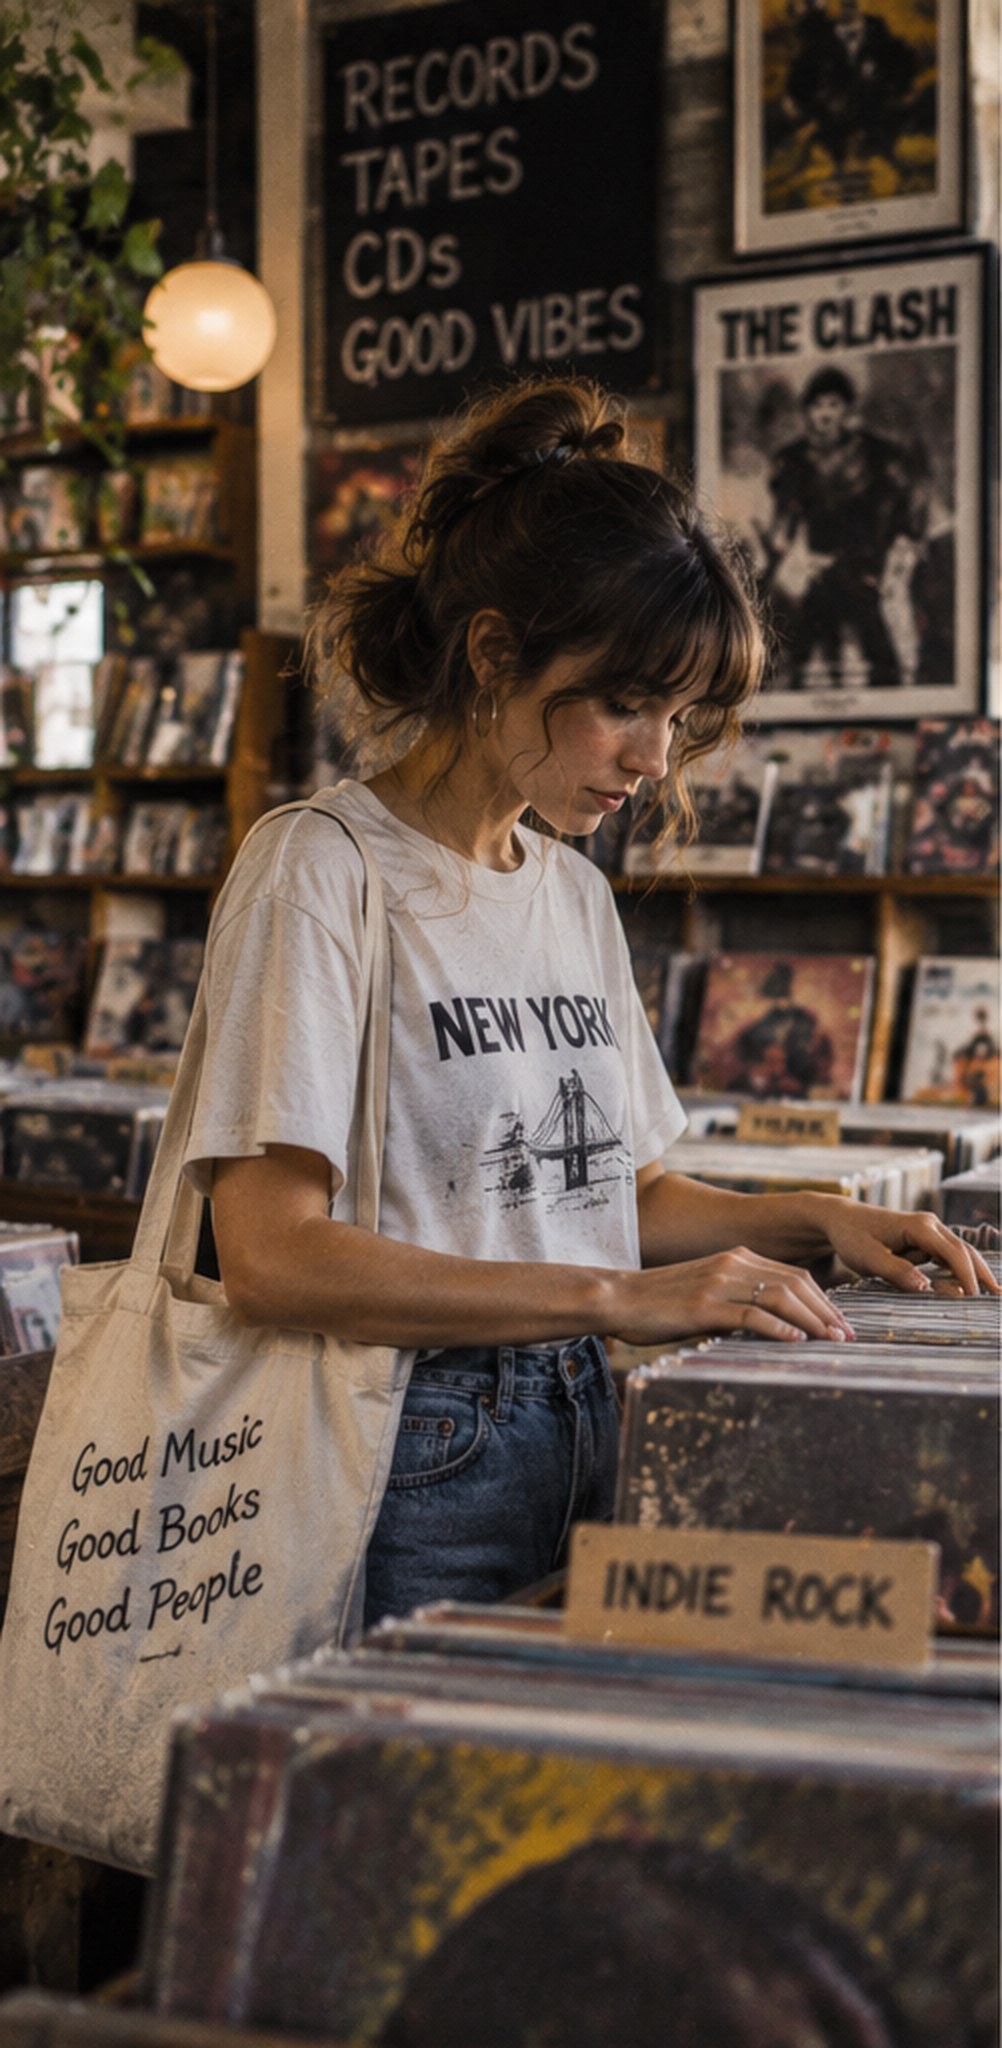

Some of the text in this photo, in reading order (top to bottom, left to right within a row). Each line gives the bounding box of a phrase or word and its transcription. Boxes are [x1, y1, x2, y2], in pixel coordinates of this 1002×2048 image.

[343, 22, 598, 132] RECORDS
[341, 126, 523, 215] TAPES
[343, 228, 462, 299] CDs
[341, 284, 643, 388] GOOD VIBES
[718, 285, 957, 360] THE CLASH
[429, 995, 616, 1062] NEW YORK
[72, 1414, 264, 1497] Good Music
[57, 1482, 261, 1575] Good Books
[44, 1549, 264, 1656] Good People
[603, 1561, 894, 1630] INDIE ROCK
